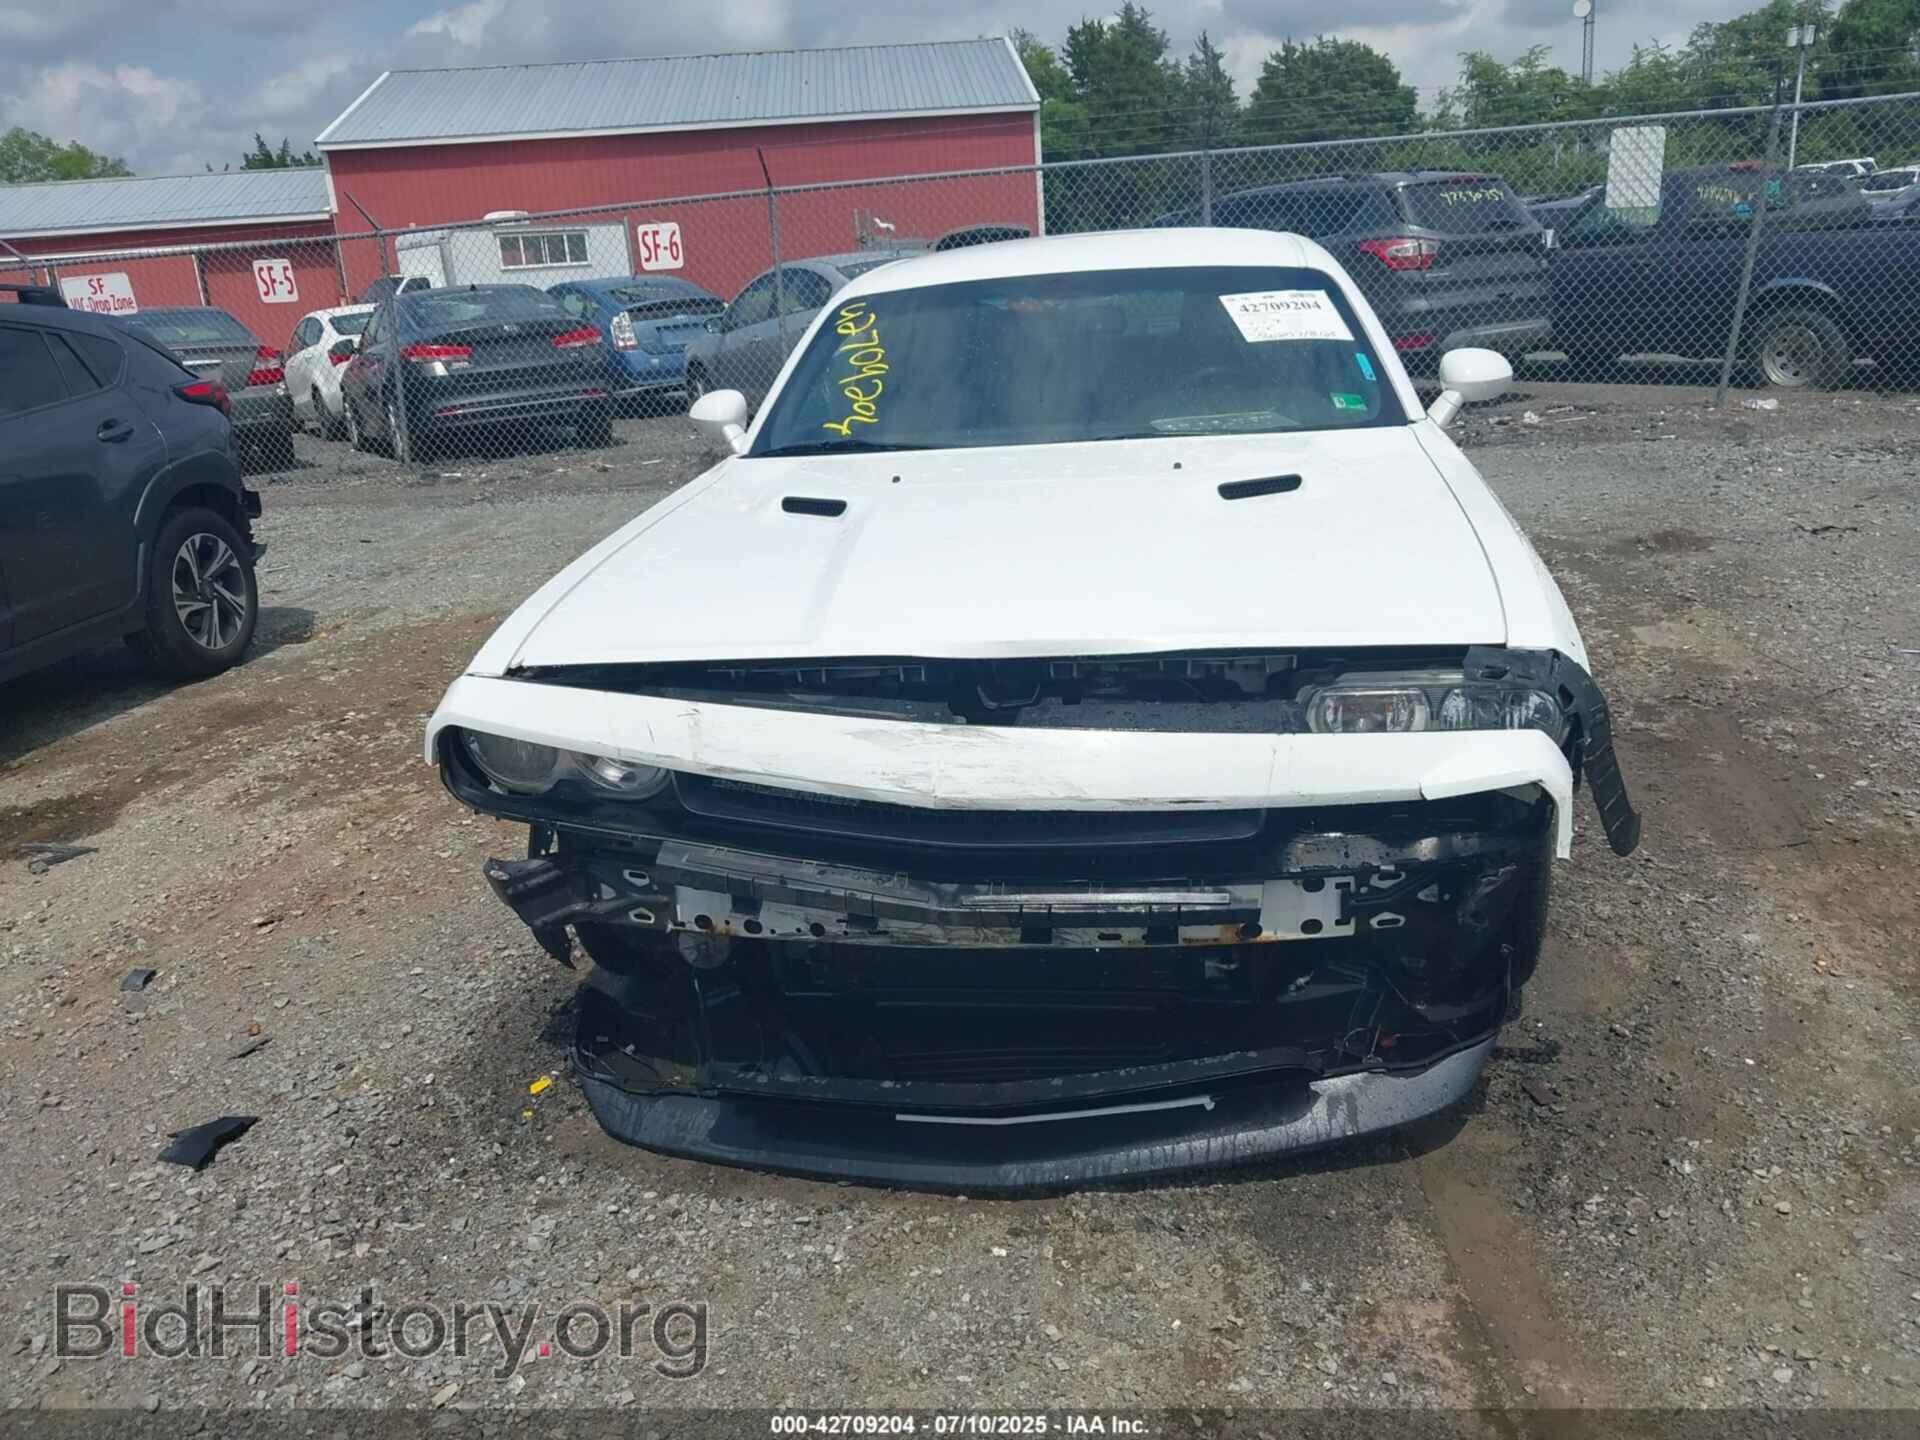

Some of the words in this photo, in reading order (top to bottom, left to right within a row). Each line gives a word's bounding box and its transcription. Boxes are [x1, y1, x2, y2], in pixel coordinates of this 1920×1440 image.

[641, 230, 679, 262] SF-6
[87, 278, 104, 295] SF
[258, 265, 294, 296] SF-5
[110, 294, 135, 311] Zone
[1240, 300, 1322, 312] 42709204
